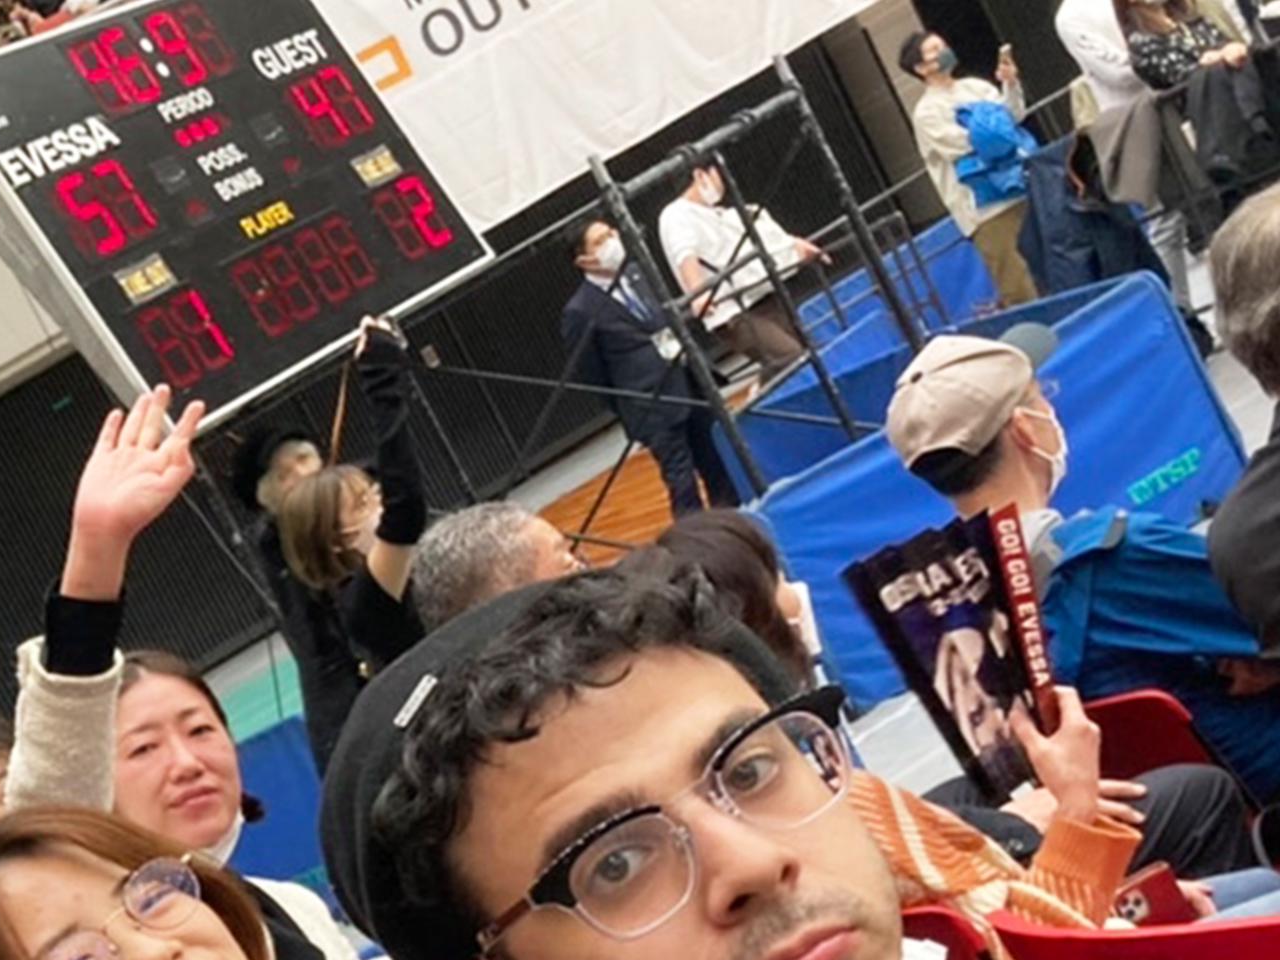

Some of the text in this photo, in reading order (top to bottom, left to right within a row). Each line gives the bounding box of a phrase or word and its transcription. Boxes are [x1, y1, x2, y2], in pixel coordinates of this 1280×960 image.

[251, 29, 328, 80] GUEST
[421, 0, 530, 57] OU
[157, 86, 215, 124] PERIOD
[289, 64, 375, 138] 47
[55, 158, 158, 257] 57
[213, 166, 264, 202] BONUS
[239, 201, 295, 240] PLAYER
[996, 517, 1051, 688] GO! GO! EVESSA
